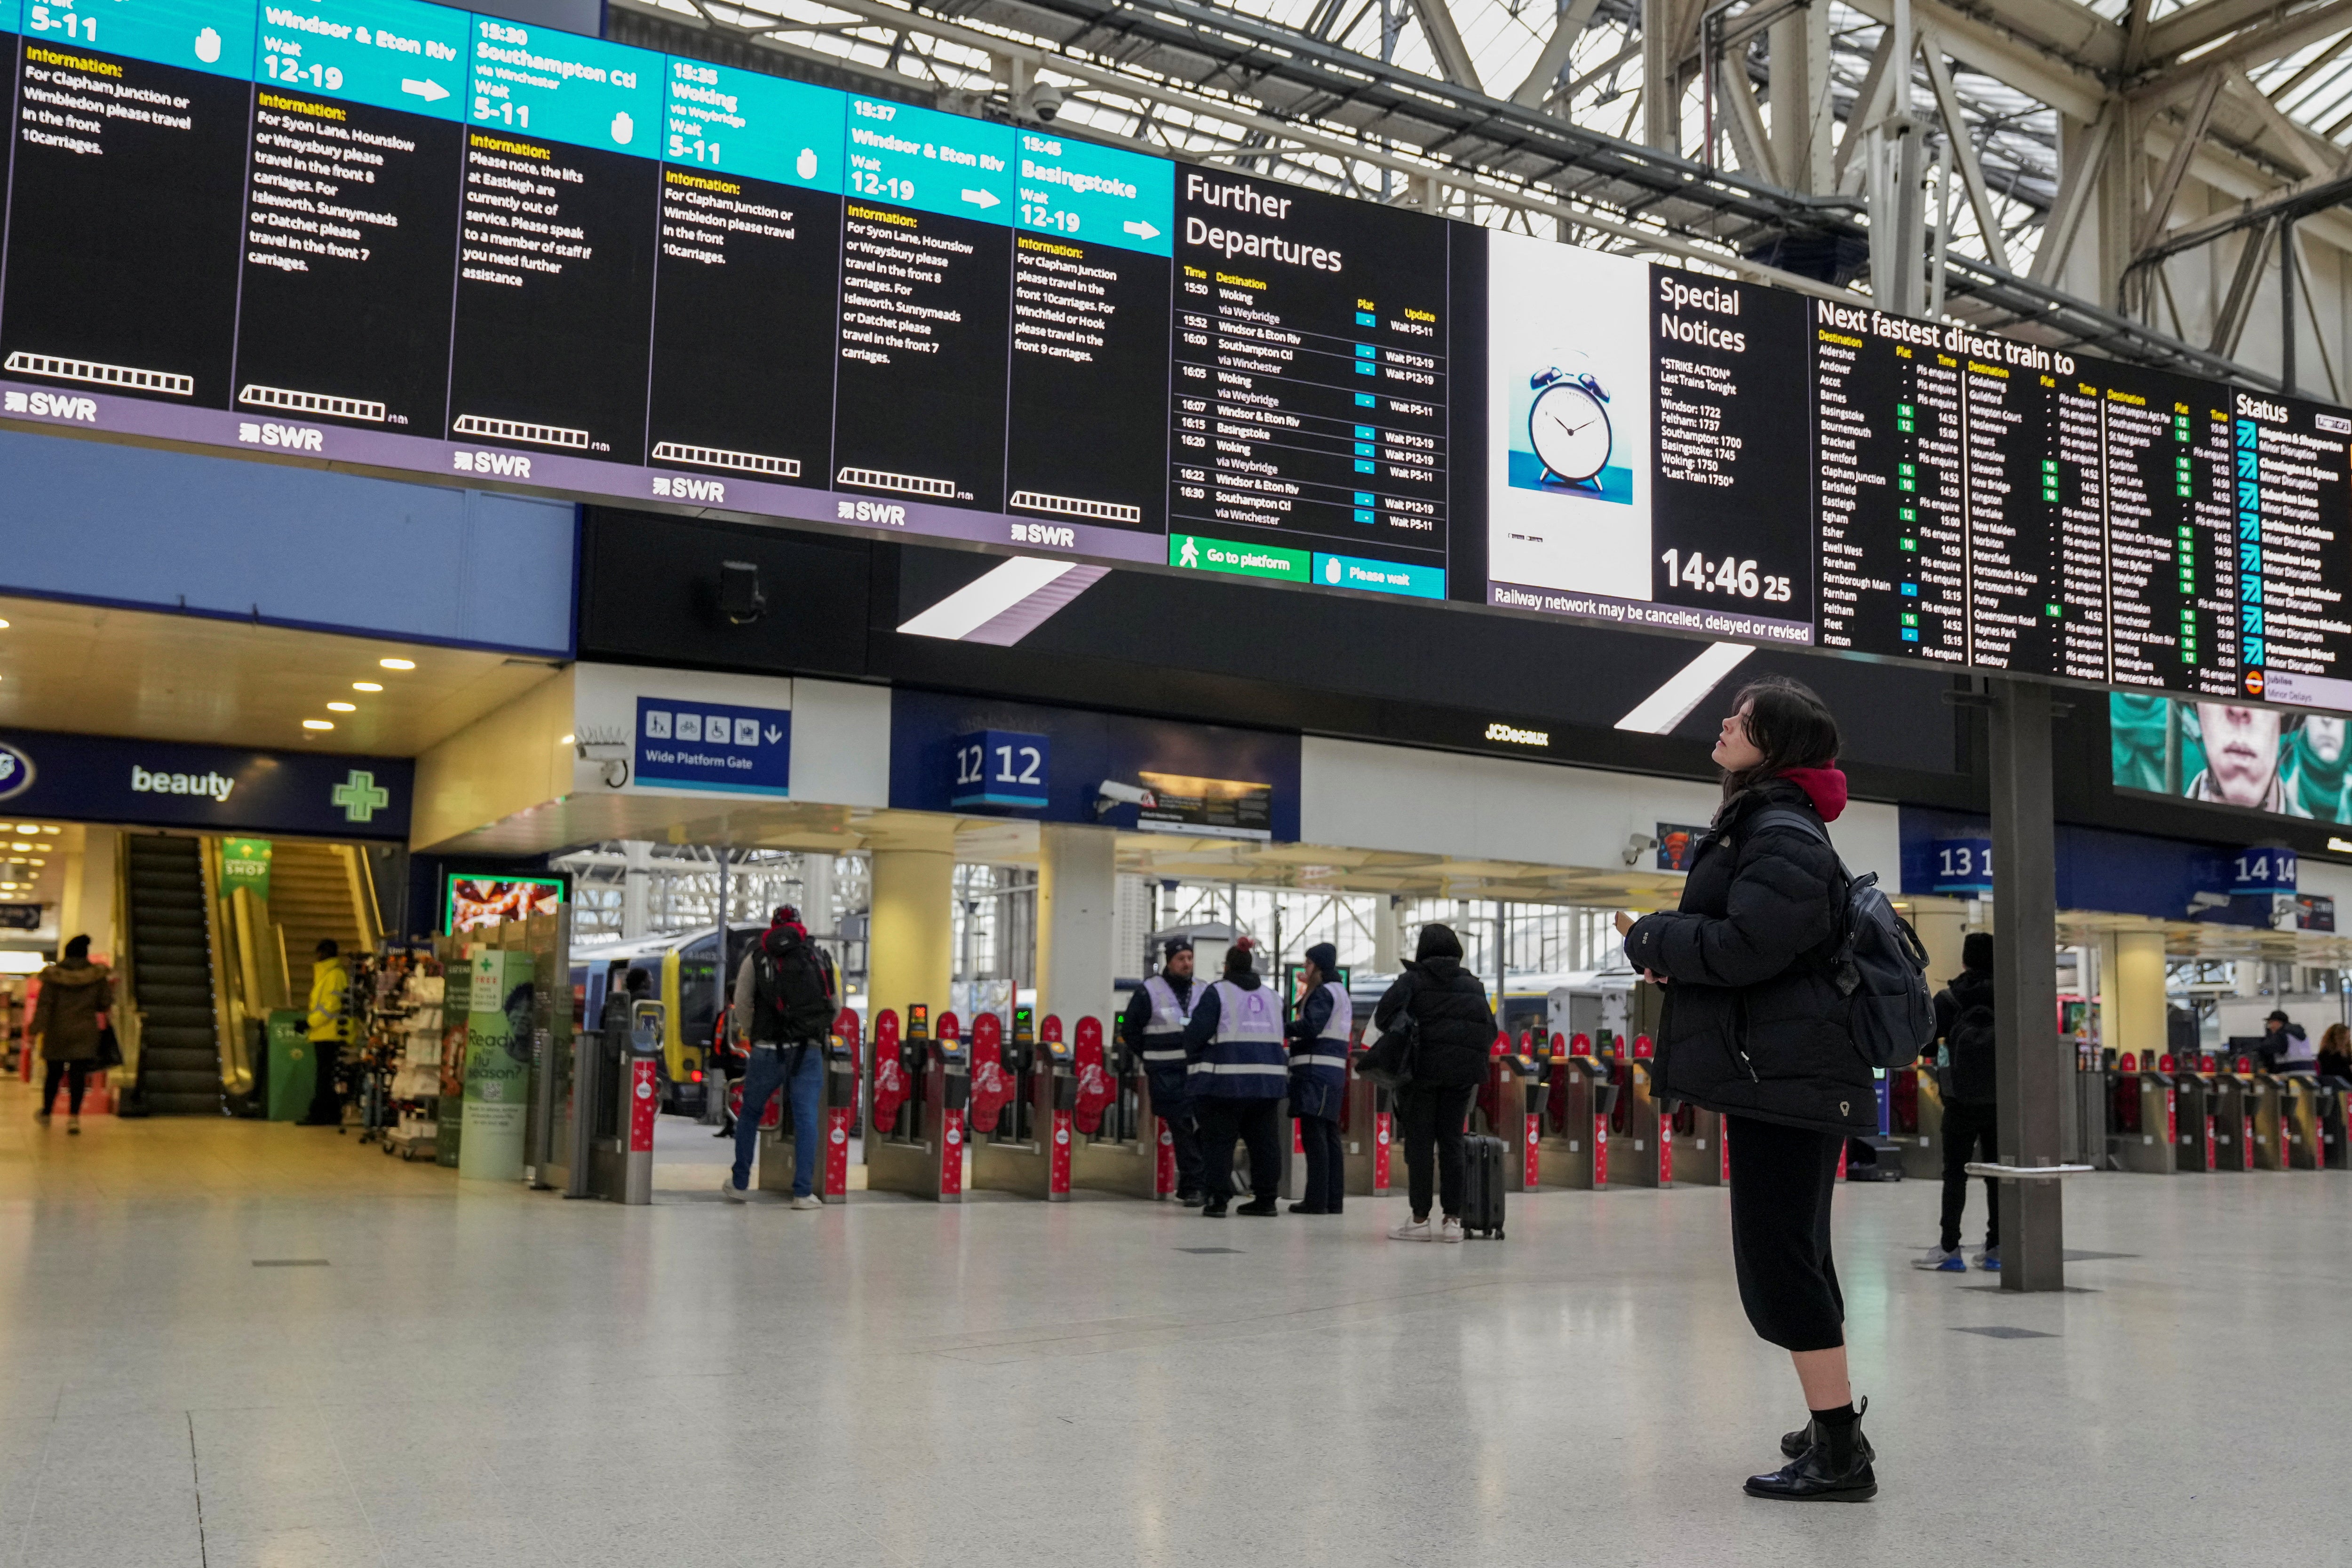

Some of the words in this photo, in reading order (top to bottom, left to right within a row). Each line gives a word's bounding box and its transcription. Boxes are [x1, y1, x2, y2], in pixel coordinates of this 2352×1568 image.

[31, 5, 96, 41] 5-11
[266, 6, 352, 39] Windsor
[355, 26, 371, 44] &
[376, 30, 421, 54] Eton
[425, 40, 456, 61] Riv
[479, 22, 527, 45] 15:30
[264, 36, 301, 56] Wait
[264, 55, 342, 89] 12-19
[477, 42, 606, 82] Southampton
[610, 70, 636, 88] Ctl
[476, 65, 493, 76] via
[495, 67, 560, 89] Winchester
[475, 79, 509, 99] Wait
[671, 81, 737, 112] Woking
[474, 96, 528, 127] 5-11
[670, 104, 686, 115] via
[688, 107, 745, 128] Weybridge
[854, 100, 896, 121] 15:37
[669, 118, 701, 136] Wait
[668, 135, 719, 164] 5-11
[851, 128, 921, 154] Windsor
[923, 143, 936, 158] &
[940, 146, 976, 166] Eton
[980, 154, 1004, 171] Riv
[1022, 136, 1061, 156] 15:45
[851, 154, 881, 171] Wait
[851, 171, 914, 200] 12-19
[1022, 159, 1136, 198] Basingstoke
[1020, 188, 1048, 204] Wait
[1187, 174, 1291, 219] Further
[1021, 204, 1080, 232] 12-19
[1018, 237, 1083, 259] Information:
[1187, 217, 1341, 271] Departures
[1017, 253, 1035, 265] For
[1035, 256, 1077, 273] Clapham
[1077, 264, 1116, 280] Junction
[1184, 265, 1207, 279] Time
[1017, 270, 1048, 285] please
[1049, 277, 1076, 290] travel
[1077, 281, 1087, 292] in
[1088, 283, 1104, 295] the
[1184, 282, 1208, 294] 15:50
[1216, 271, 1266, 290] Destination
[1016, 286, 1041, 301] front
[1042, 292, 1097, 311] 10carriages.
[1098, 302, 1115, 314] For
[1219, 288, 1253, 305] Woking
[1357, 299, 1374, 310] Plat
[1661, 277, 1739, 315] Special
[1015, 304, 1065, 322] Winchfield
[1066, 315, 1078, 324] or
[1079, 316, 1104, 329] Hook
[1184, 315, 1207, 328] 15:52
[1218, 305, 1232, 315] via
[1233, 307, 1280, 325] Weybridge
[1405, 308, 1435, 322] Update
[1015, 322, 1046, 336] please
[1047, 328, 1075, 341] travel
[1076, 332, 1085, 343] in
[1086, 334, 1103, 346] the
[1218, 321, 1256, 336] Windsor
[1256, 328, 1264, 338] &
[1265, 329, 1286, 342] Eton
[1287, 333, 1301, 344] Riv
[1391, 320, 1409, 333] Wait
[1411, 324, 1432, 337] P5-11
[1661, 313, 1745, 352] Notices
[1818, 299, 1867, 332] Next
[1871, 310, 1940, 348] fastest
[1945, 327, 2002, 361] direct
[2004, 341, 2050, 371] train
[2053, 351, 2074, 375] to
[1818, 329, 1862, 348] Destination
[1014, 338, 1039, 352] front
[1041, 343, 1048, 354] 9
[1048, 347, 1093, 362] carriages.
[1385, 351, 1405, 363] Wait
[1406, 355, 1434, 368] P12-19
[1819, 344, 1855, 360] Aldershot
[1896, 345, 1912, 358] Plat
[1937, 354, 1956, 367] Time
[1819, 359, 1851, 374] Andover
[1661, 371, 1678, 384] Last
[1679, 374, 1705, 388] Trains
[1705, 379, 1736, 396] Tonight
[1661, 385, 1672, 396] to:
[1820, 374, 1841, 387] Ascot
[29, 392, 96, 421] SWR
[1661, 397, 1698, 414] Windsor:
[1700, 404, 1721, 418] 1722
[1820, 389, 1847, 403] Barnes
[1901, 406, 1910, 415] 16
[1938, 412, 1958, 425] 14:52
[2236, 393, 2288, 423] Status
[1661, 411, 1697, 427] Feltham:
[1699, 418, 1720, 431] 1737
[262, 423, 322, 451] SWR
[1661, 425, 1718, 444] Southampton:
[1721, 435, 1741, 449] 1700
[1661, 438, 1712, 457] Basingstoke:
[1715, 448, 1735, 461] 1745
[471, 451, 531, 478] SWR
[1661, 452, 1695, 470] Woking:
[1697, 458, 1718, 471] 1750
[669, 477, 724, 502] SWR
[852, 501, 905, 525] SWR
[1024, 524, 1074, 547] SWR
[1207, 548, 1224, 562] Go
[1225, 552, 1239, 563] to
[1240, 553, 1289, 570] platform
[1350, 567, 1384, 582] Please
[1387, 574, 1409, 586] wait
[1661, 548, 1759, 597] 14:46
[1764, 575, 1791, 602] 25
[1495, 587, 1542, 610] Railway
[1545, 596, 1596, 614] network
[1598, 603, 1625, 620] may
[1628, 604, 1643, 620] be
[1645, 610, 1702, 629] cancelled,
[1705, 615, 1750, 634] delayed
[1753, 623, 1765, 635] or
[1768, 625, 1808, 641] revised
[1824, 602, 1854, 616] Feltham
[1824, 618, 1842, 630] Fleet
[1824, 634, 1851, 646] Fratton
[1485, 723, 1549, 746] JCDecaux
[646, 749, 675, 763] Wide
[677, 752, 725, 767] Platform
[727, 756, 753, 769] Gate
[957, 744, 983, 784] 12
[996, 745, 1041, 785] 12
[131, 765, 235, 802] beauty
[1940, 847, 1972, 876] 13
[2235, 856, 2270, 881] 14
[2276, 856, 2295, 882] 14
